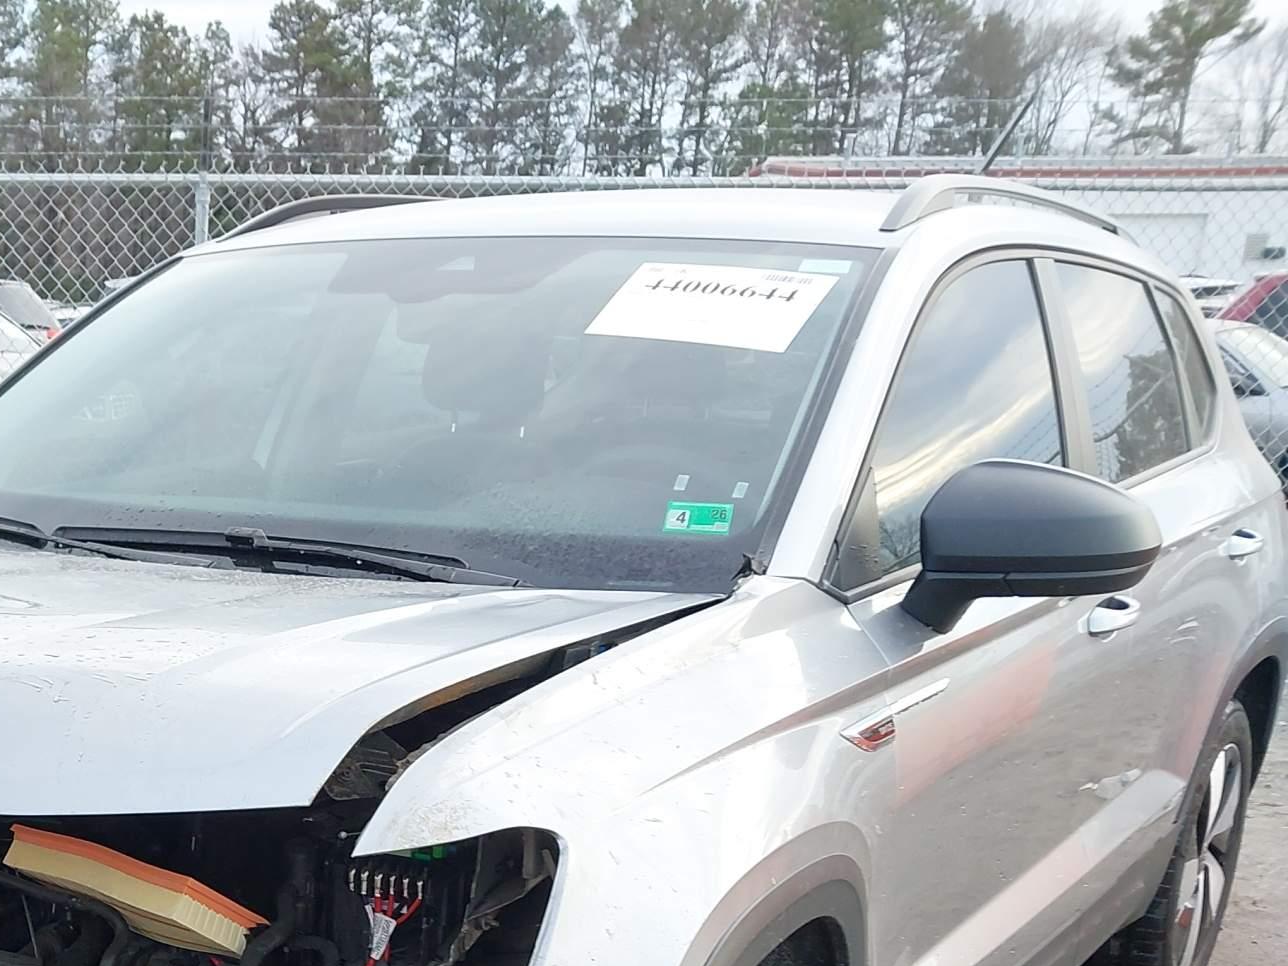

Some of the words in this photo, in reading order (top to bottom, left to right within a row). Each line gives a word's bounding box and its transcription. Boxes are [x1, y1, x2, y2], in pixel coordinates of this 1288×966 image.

[645, 279, 799, 302] 44006644
[675, 511, 687, 523] 4
[711, 509, 727, 520] 26
